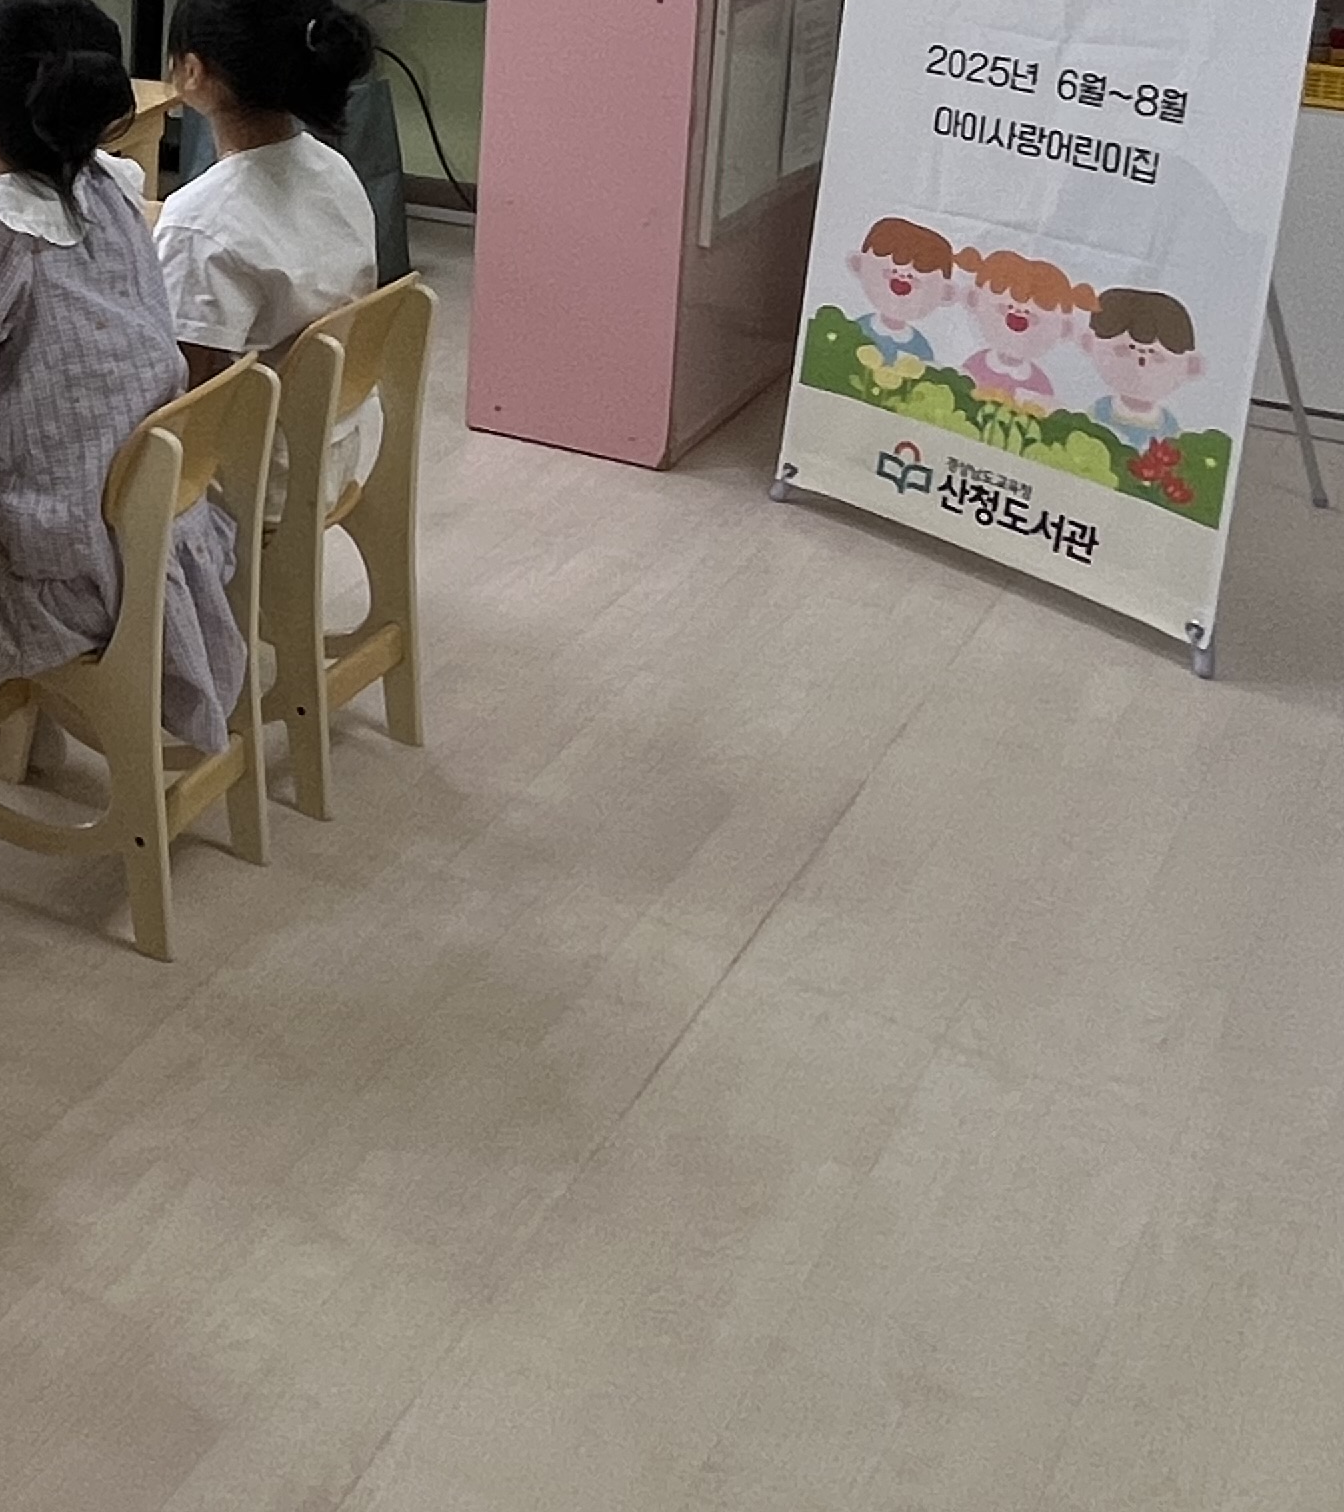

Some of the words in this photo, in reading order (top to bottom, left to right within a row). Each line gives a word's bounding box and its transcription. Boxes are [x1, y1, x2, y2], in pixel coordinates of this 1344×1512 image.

[925, 44, 1040, 94] 2025년
[1056, 68, 1189, 125] 6월~8월
[933, 105, 1162, 186] 아이사랑어린이집
[936, 474, 1100, 566] 산청도서관
